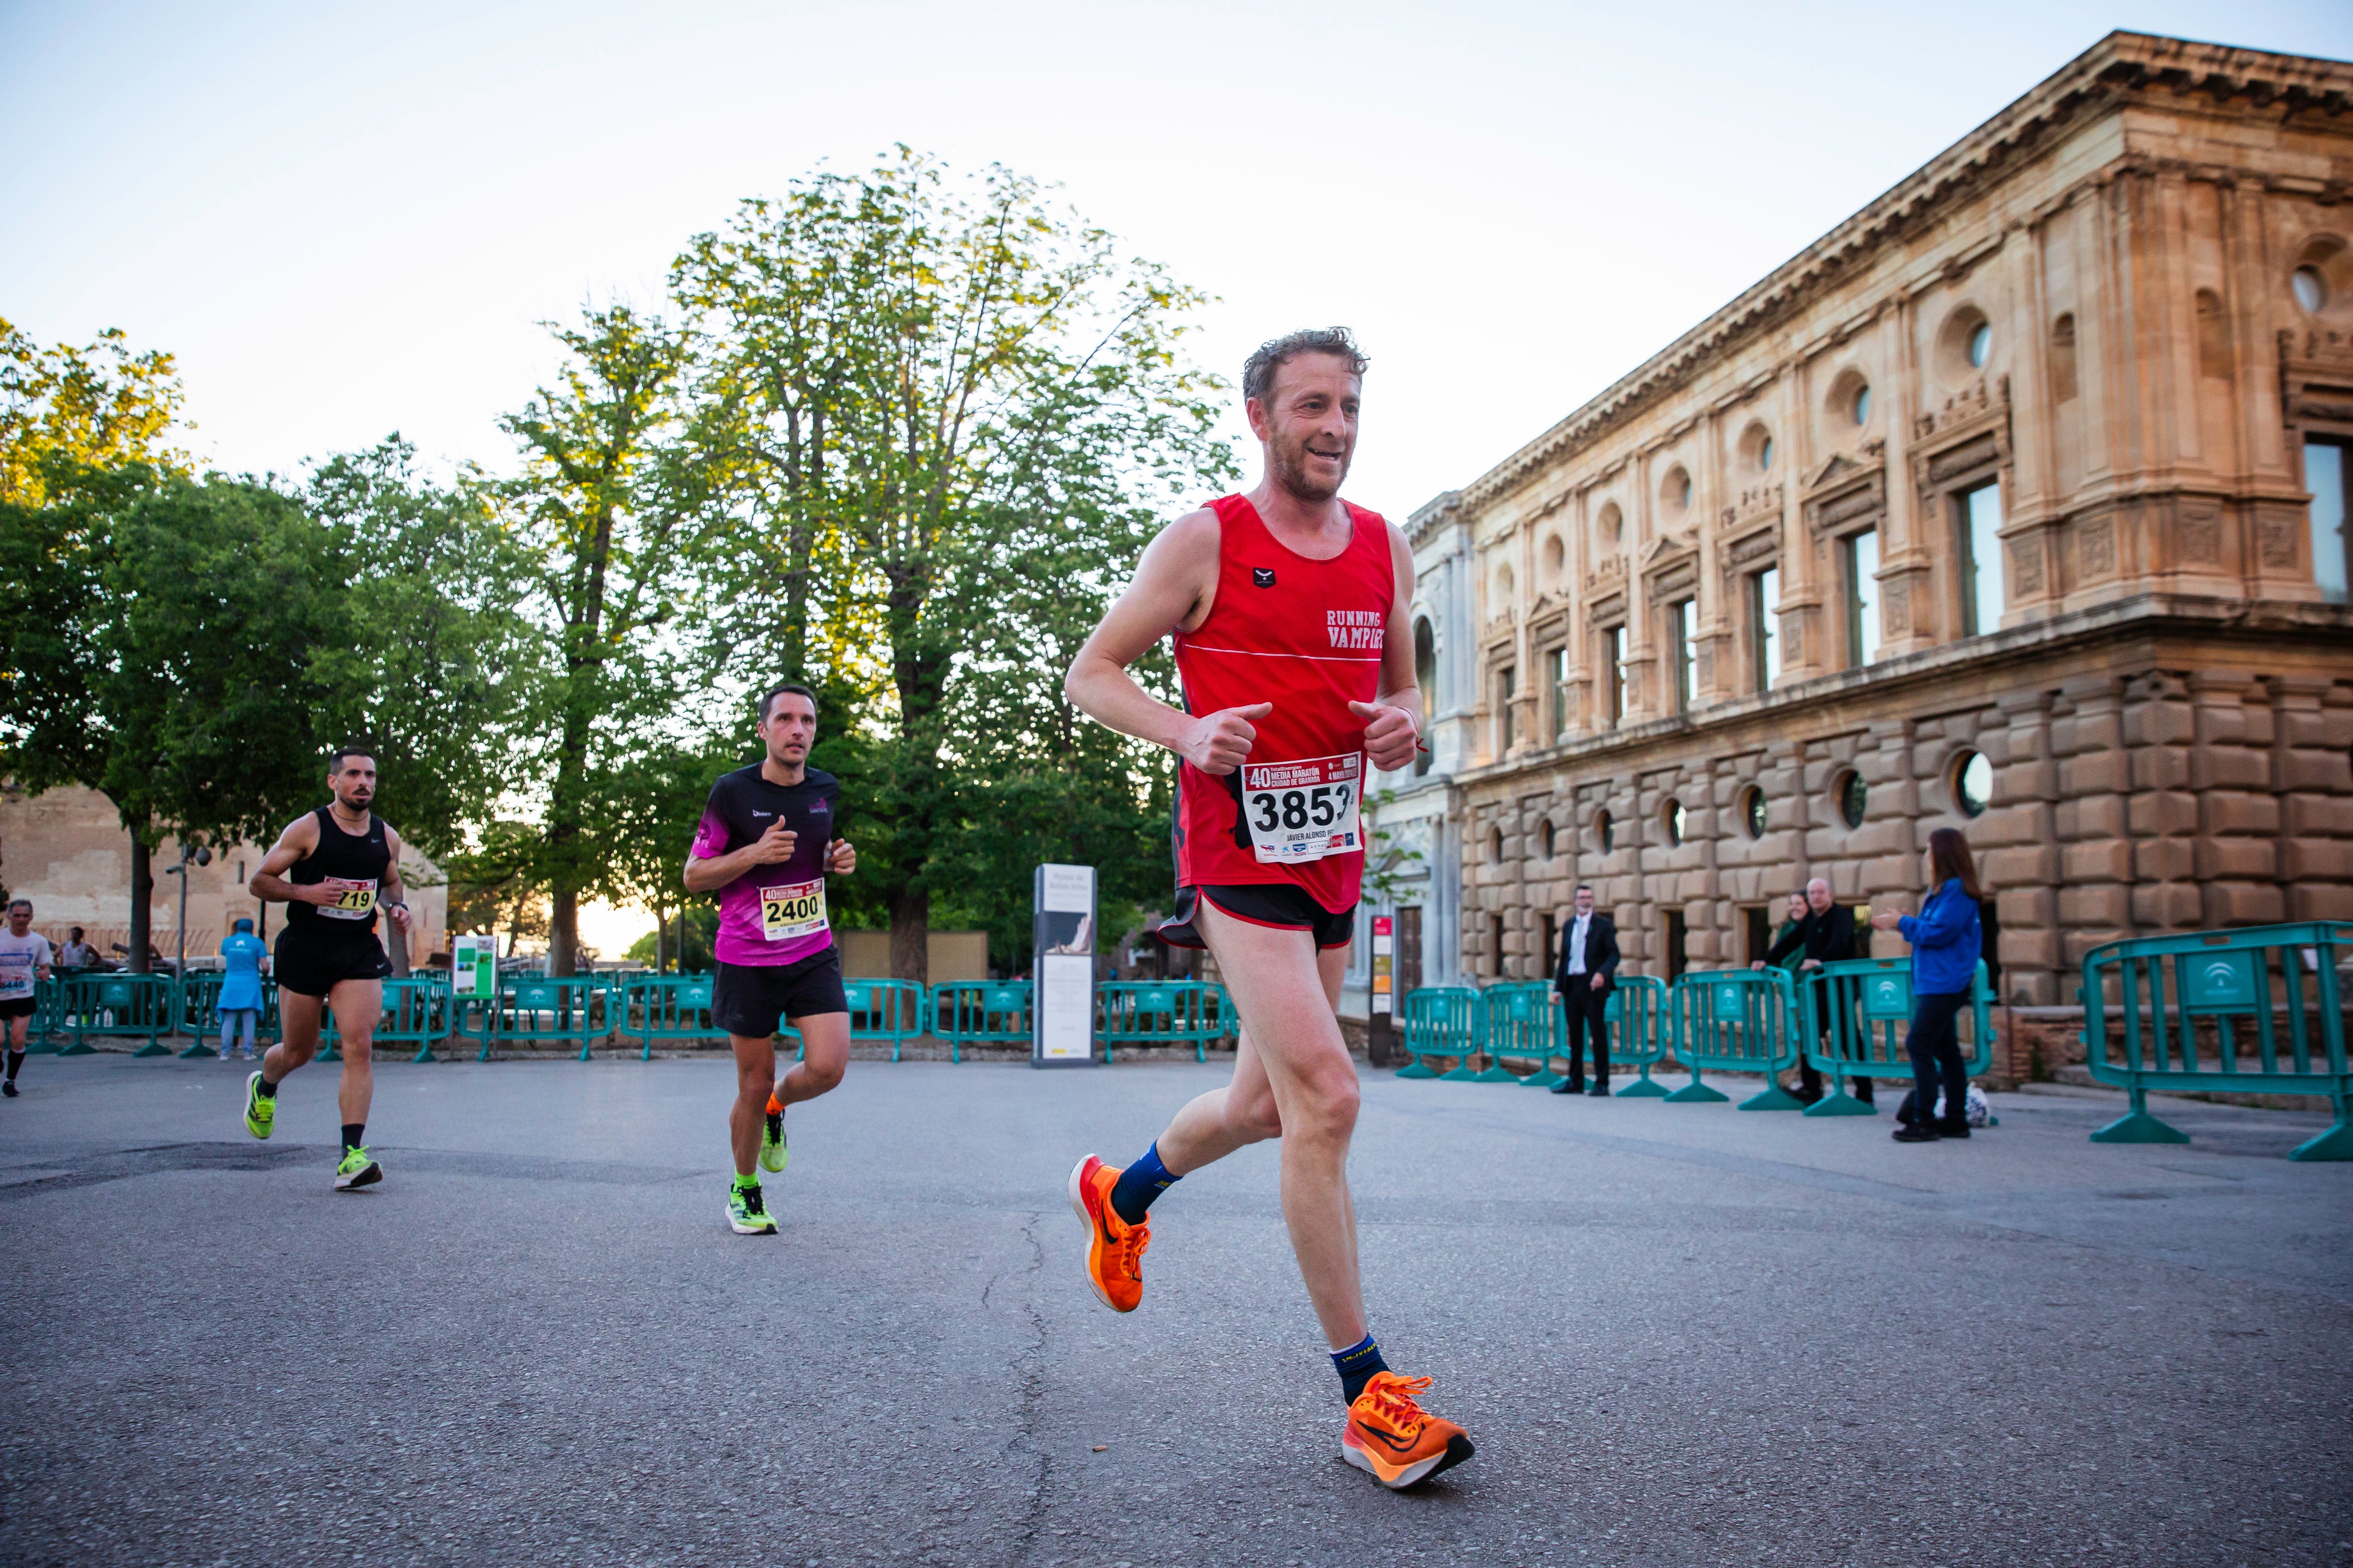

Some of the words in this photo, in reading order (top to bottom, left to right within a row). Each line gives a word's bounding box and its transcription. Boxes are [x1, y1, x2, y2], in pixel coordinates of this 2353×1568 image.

[1327, 610, 1381, 627] RUNNING
[1327, 626, 1385, 649] VAMPIR
[1249, 767, 1271, 788] 40
[1271, 770, 1291, 780] MEDIA
[1292, 765, 1320, 779] MARATÓN
[1328, 772, 1332, 781] 4
[1271, 779, 1290, 787] CIUDAD
[1298, 775, 1321, 785] GRANADA
[1252, 783, 1350, 832] 3853
[1287, 833, 1305, 842] JAVIER
[1305, 830, 1327, 840] ALONSO
[764, 889, 777, 900] 40
[766, 895, 818, 923] 2400
